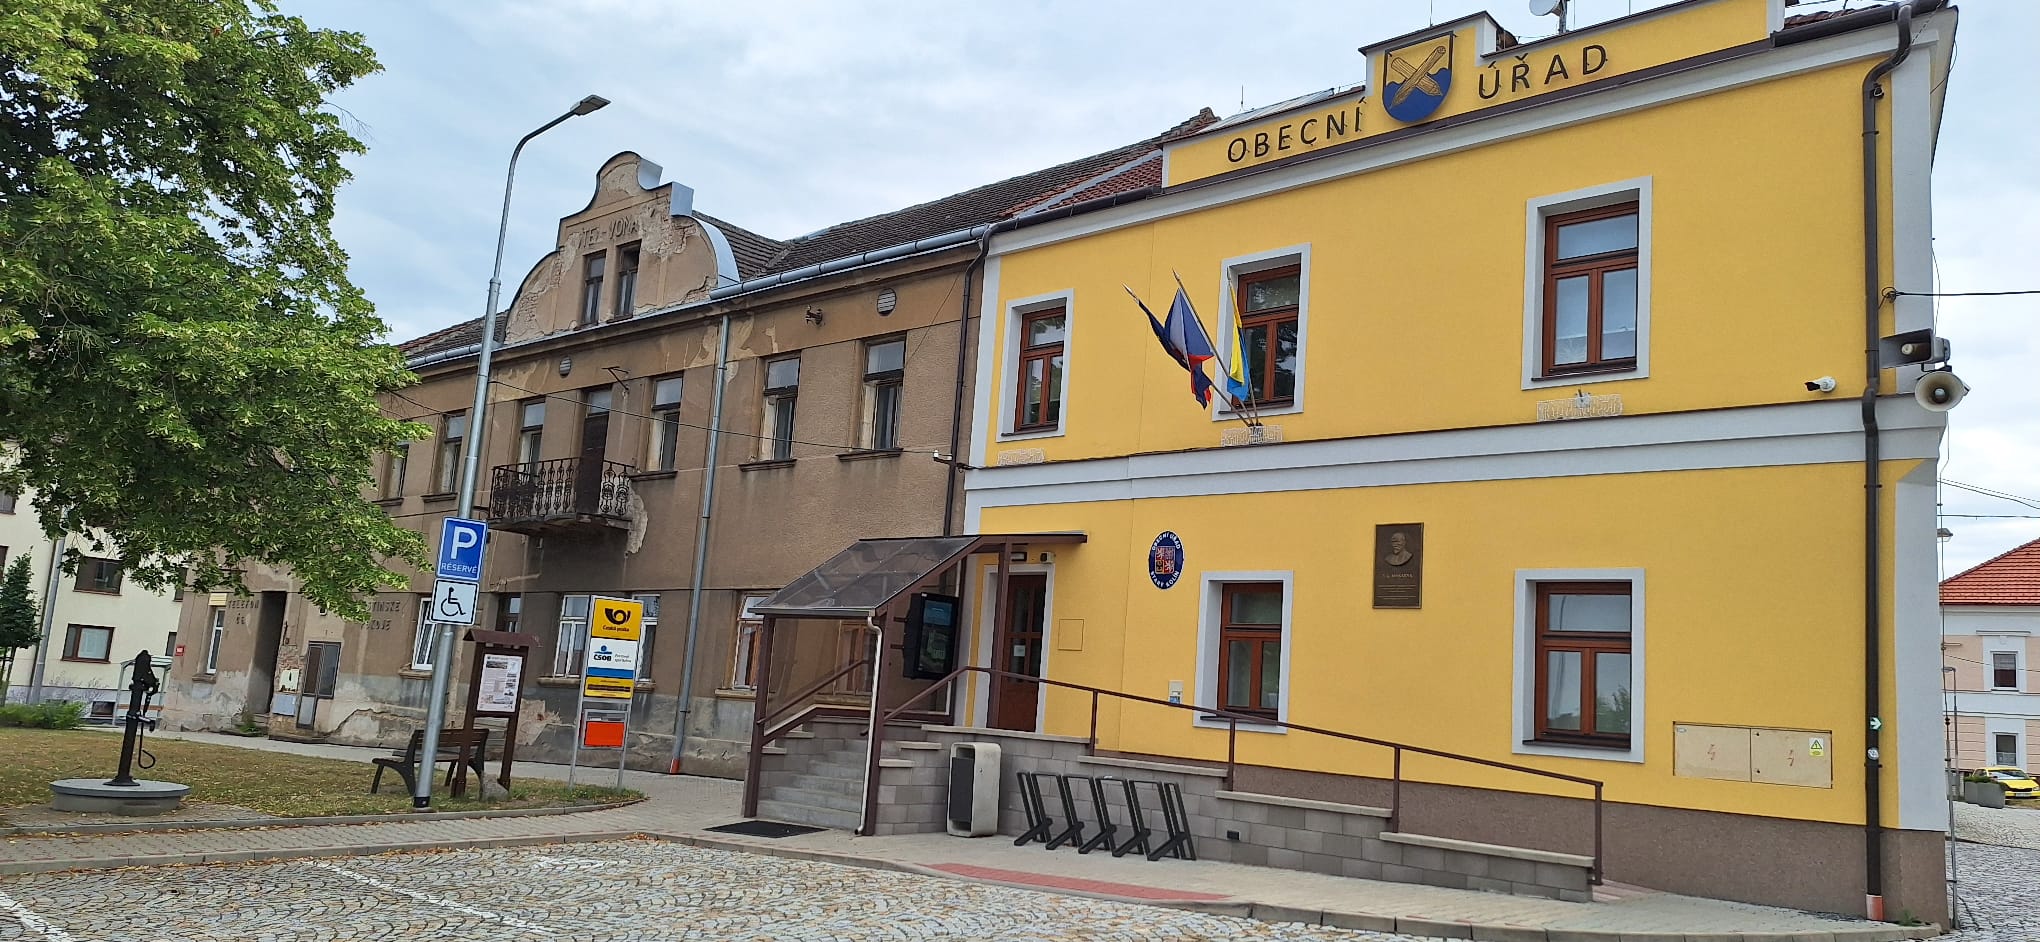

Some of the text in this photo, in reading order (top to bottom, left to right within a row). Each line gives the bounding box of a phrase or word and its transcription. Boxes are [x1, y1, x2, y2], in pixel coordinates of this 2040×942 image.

[1227, 44, 1608, 163] OBECNÍ ÚŘAD
[450, 526, 478, 560] P
